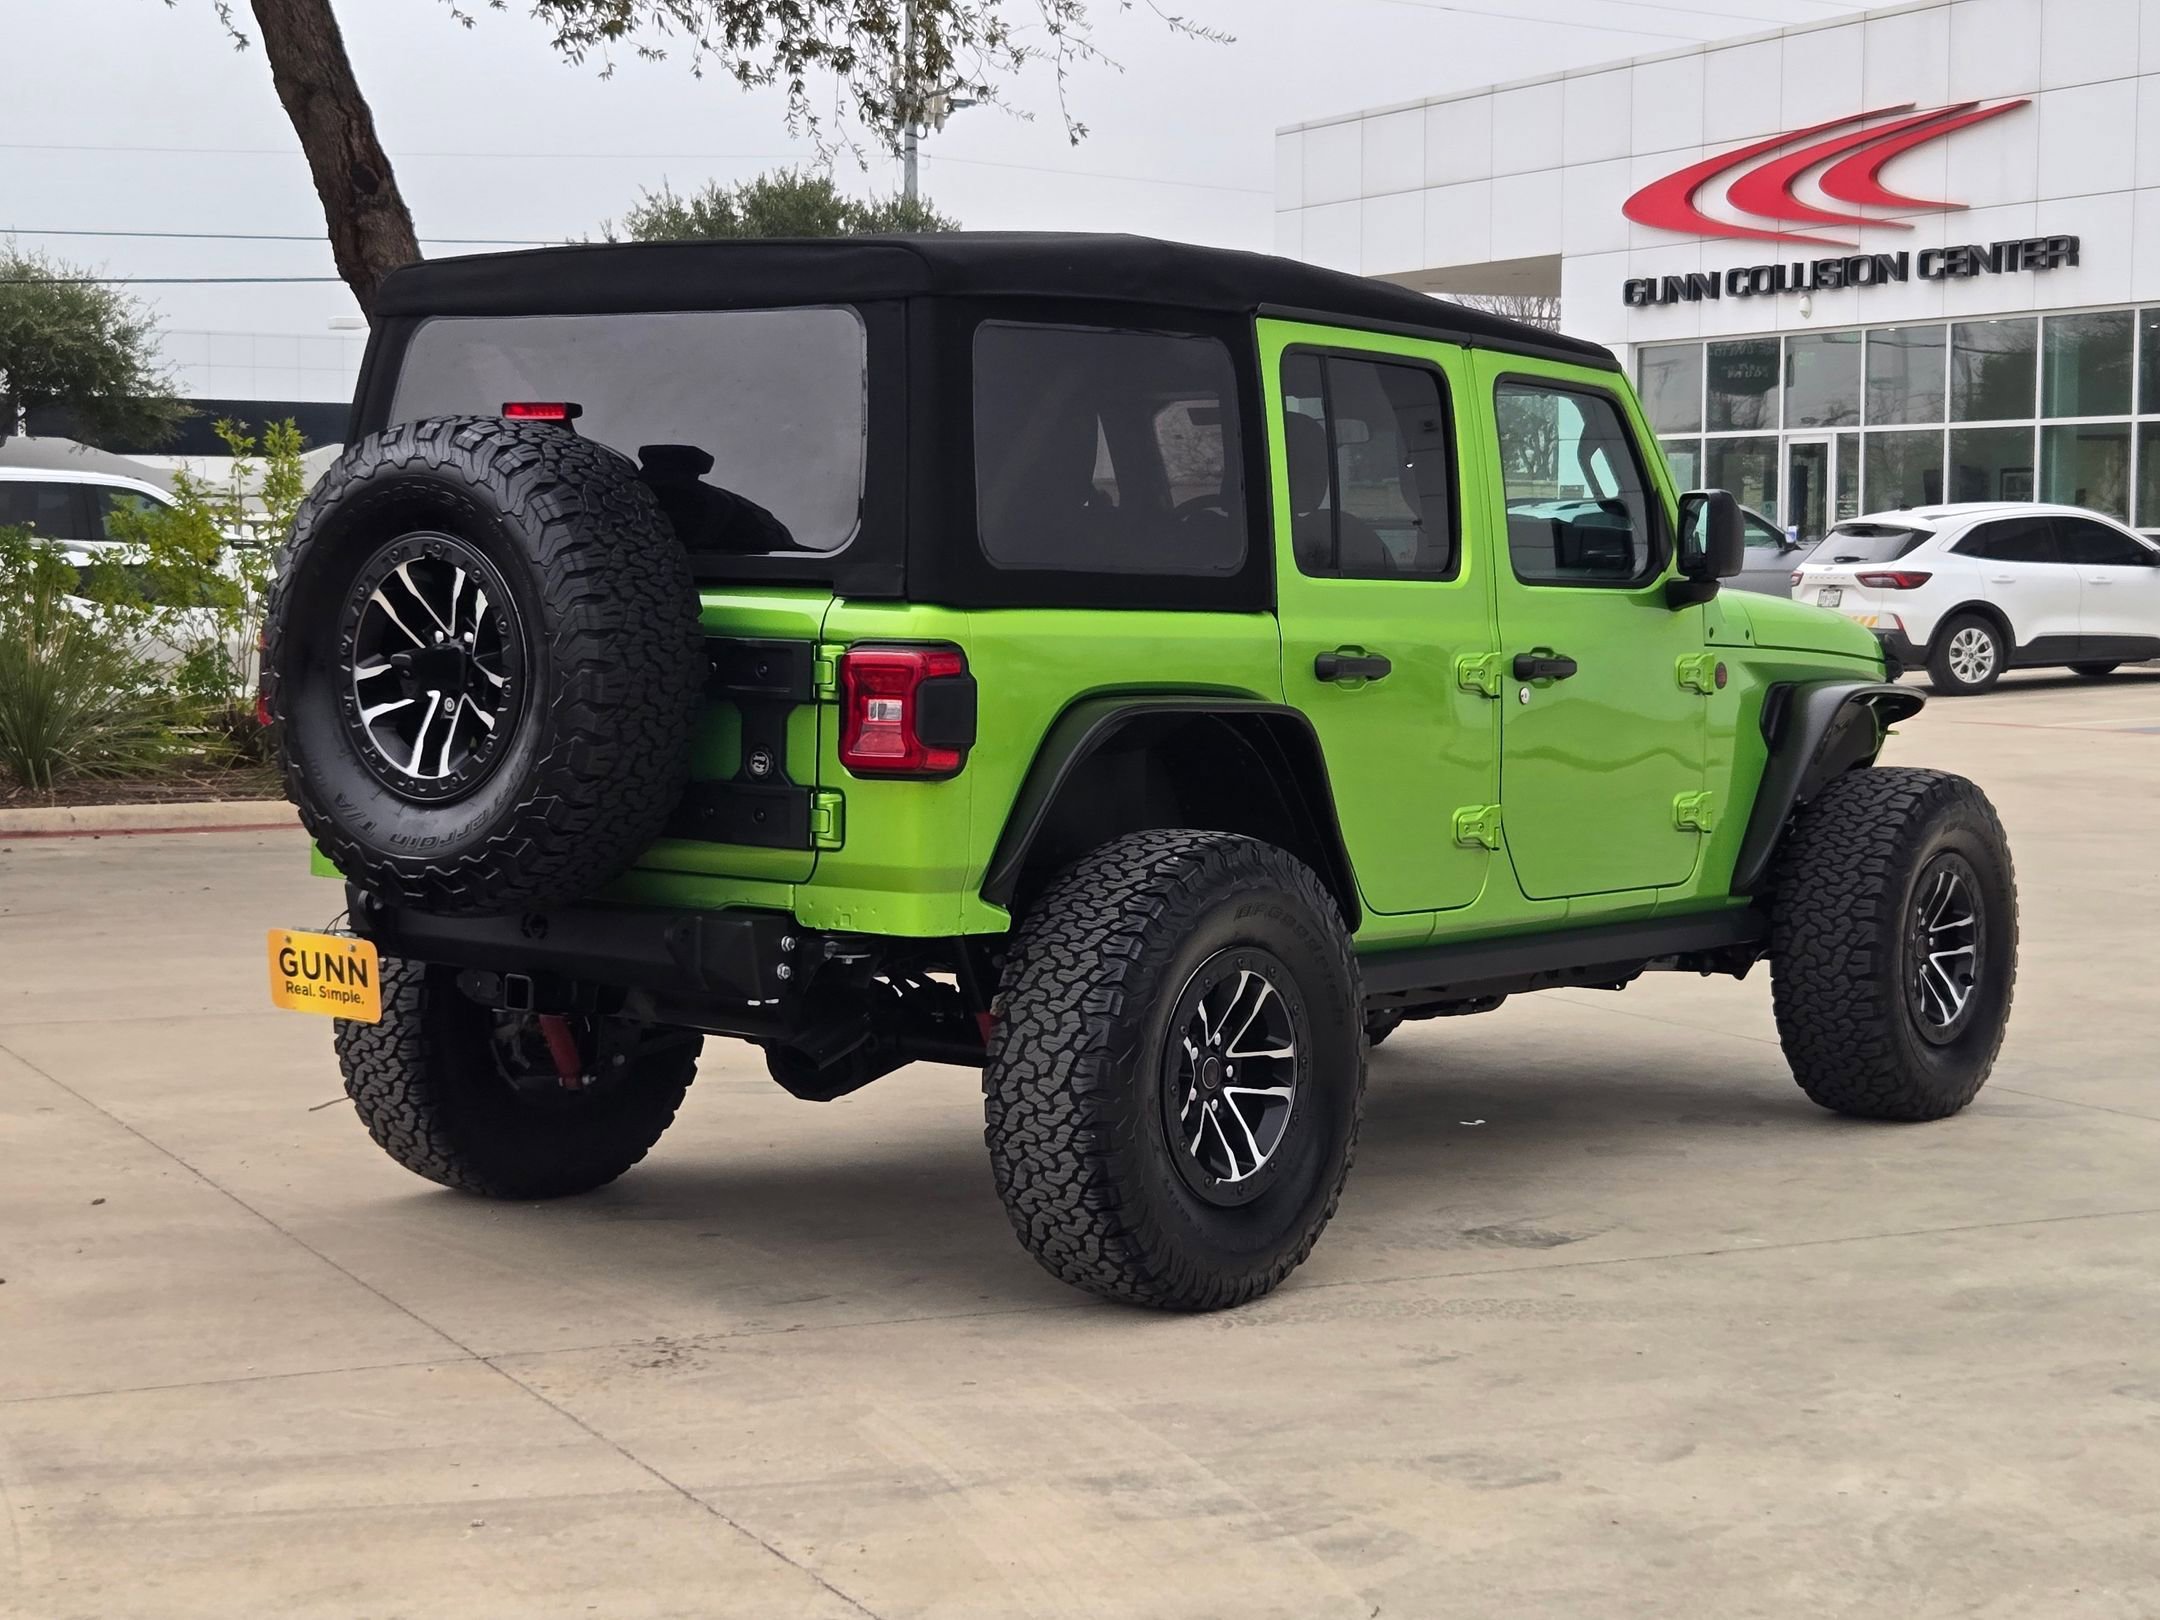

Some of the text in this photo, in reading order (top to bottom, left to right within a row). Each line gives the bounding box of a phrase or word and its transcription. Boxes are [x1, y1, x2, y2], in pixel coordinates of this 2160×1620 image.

[1623, 235, 2080, 307] GUNN COLLISION CENTER
[279, 947, 369, 988] GUNN
[286, 980, 365, 1005] Real. Simple.
